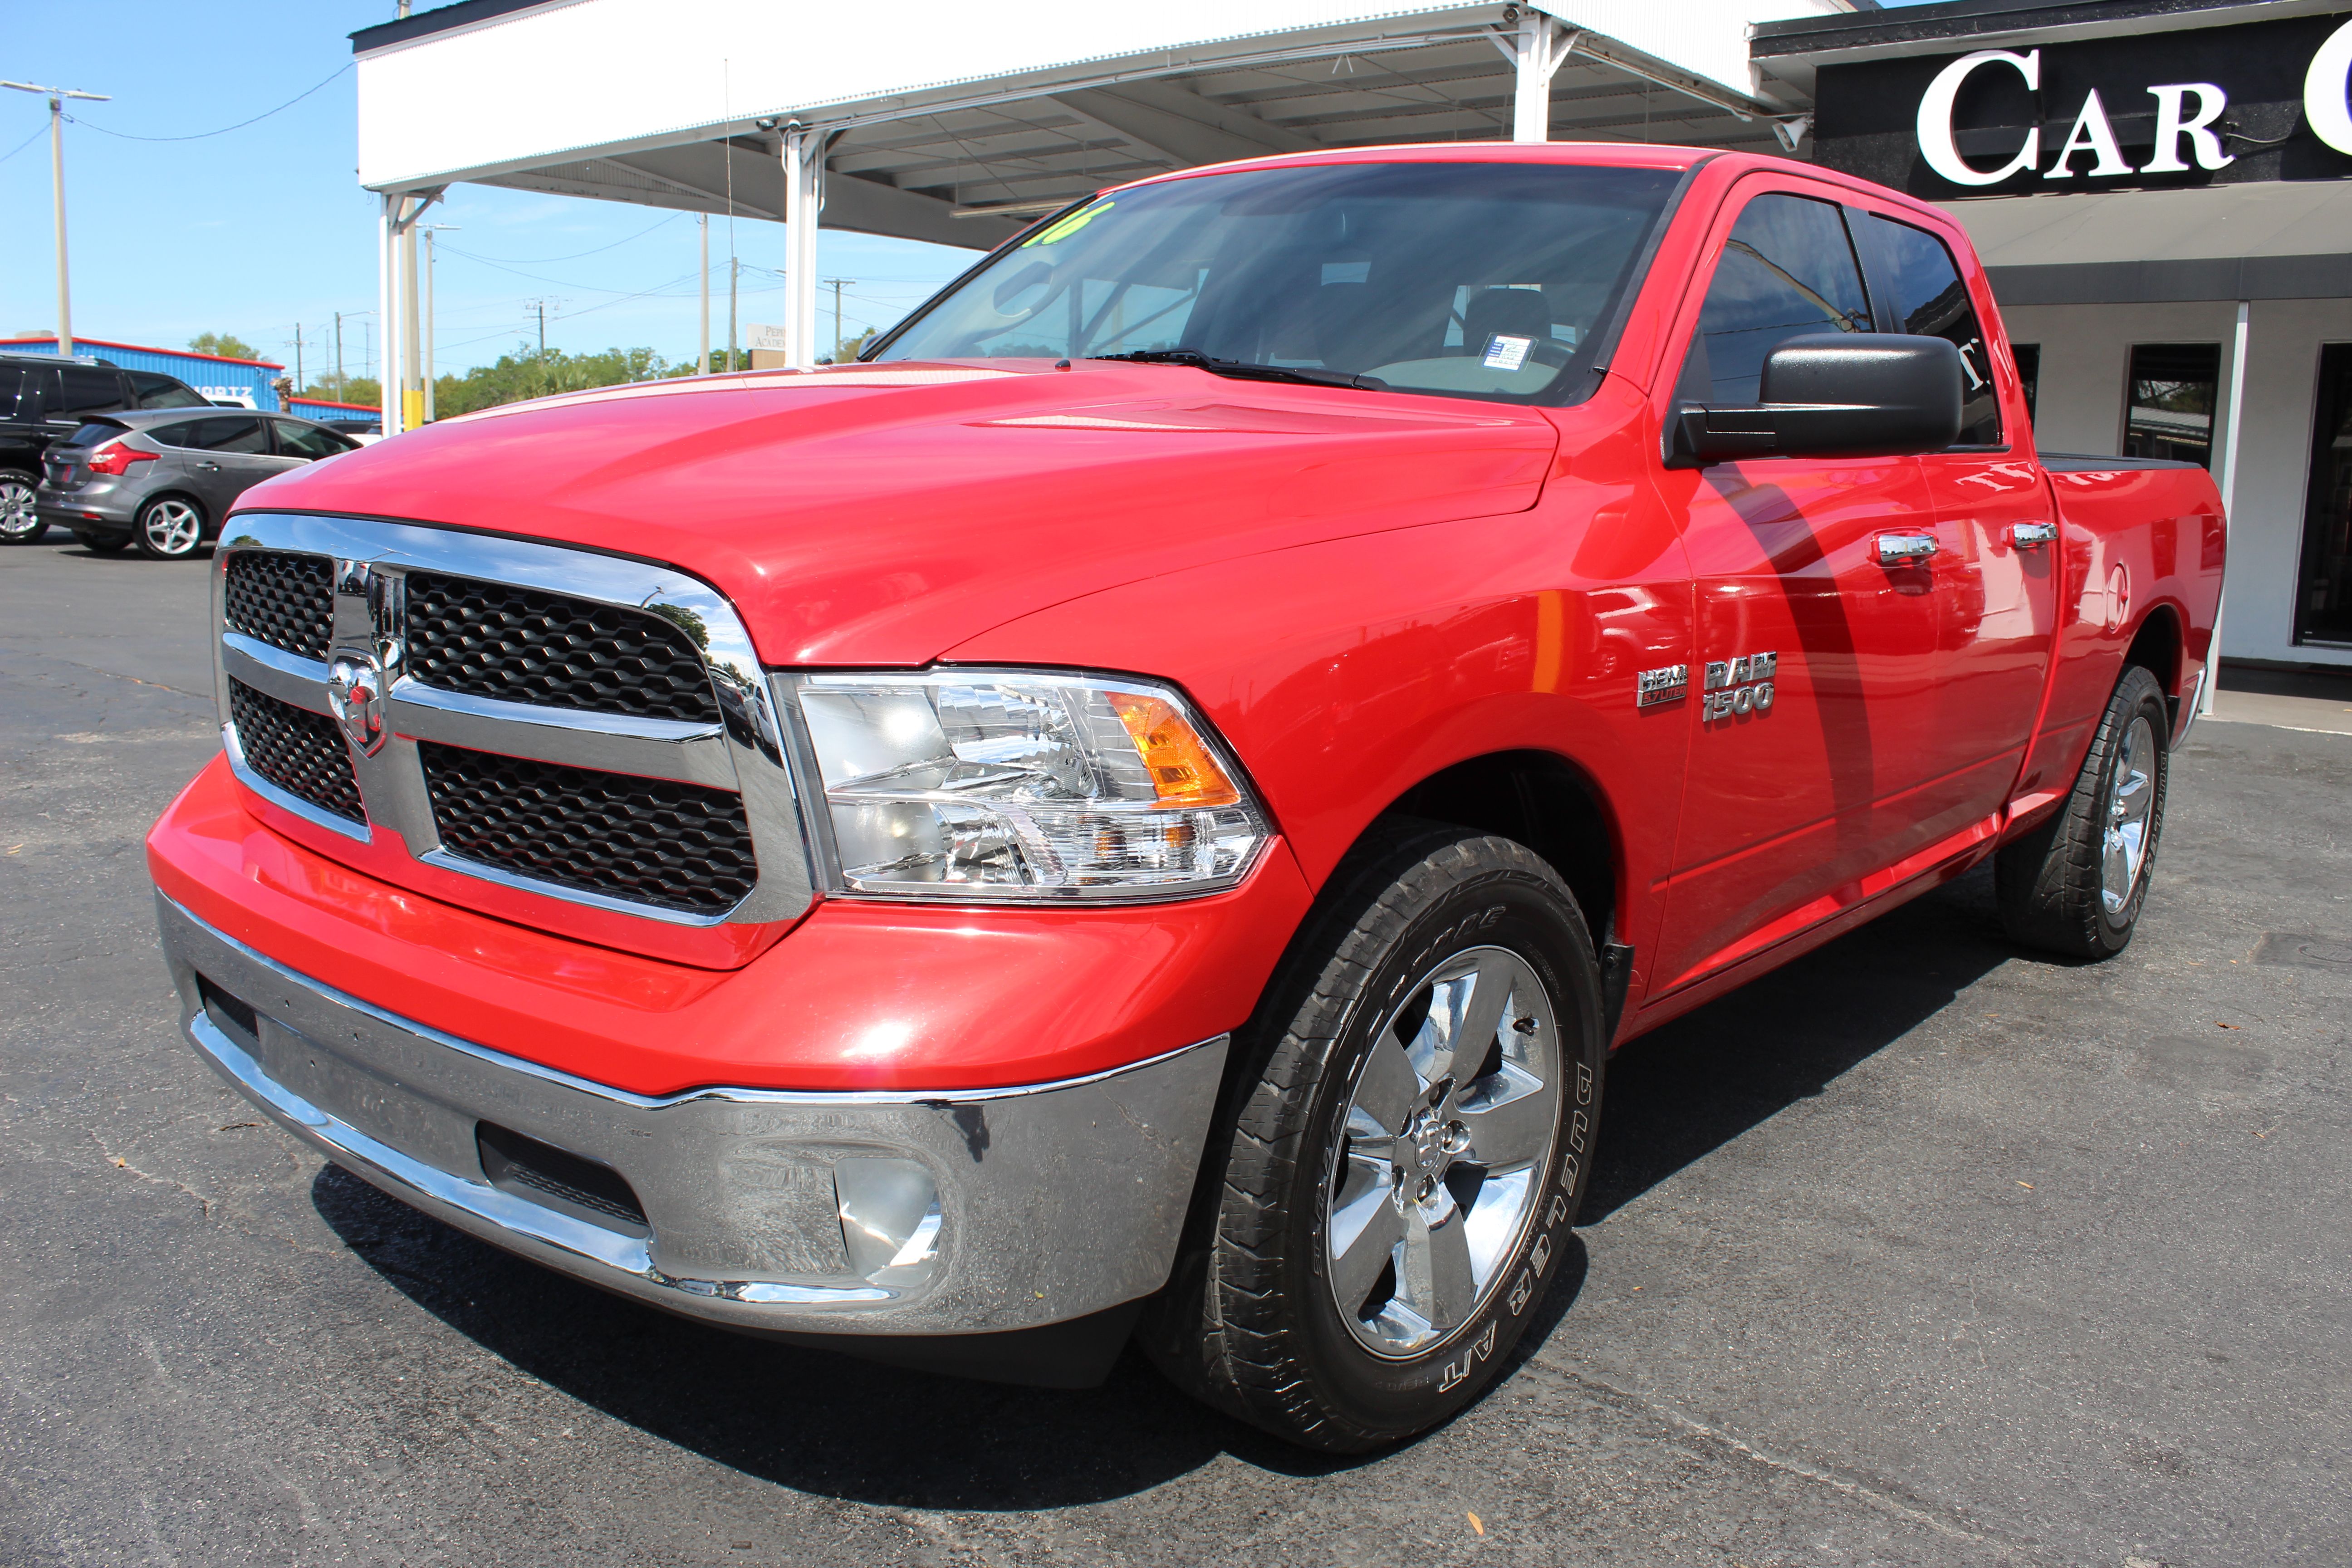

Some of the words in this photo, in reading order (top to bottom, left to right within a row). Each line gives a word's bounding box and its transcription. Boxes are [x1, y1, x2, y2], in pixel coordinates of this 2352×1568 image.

[1917, 49, 2236, 186] CAR
[1637, 664, 1688, 691] HEMI
[1704, 651, 1777, 690] RAM
[1642, 692, 1657, 704] 5.7
[1659, 685, 1686, 700] LITER
[1702, 682, 1775, 722] 1500
[1507, 1061, 1592, 1316] DUELER
[1437, 1320, 1497, 1393] A/T
